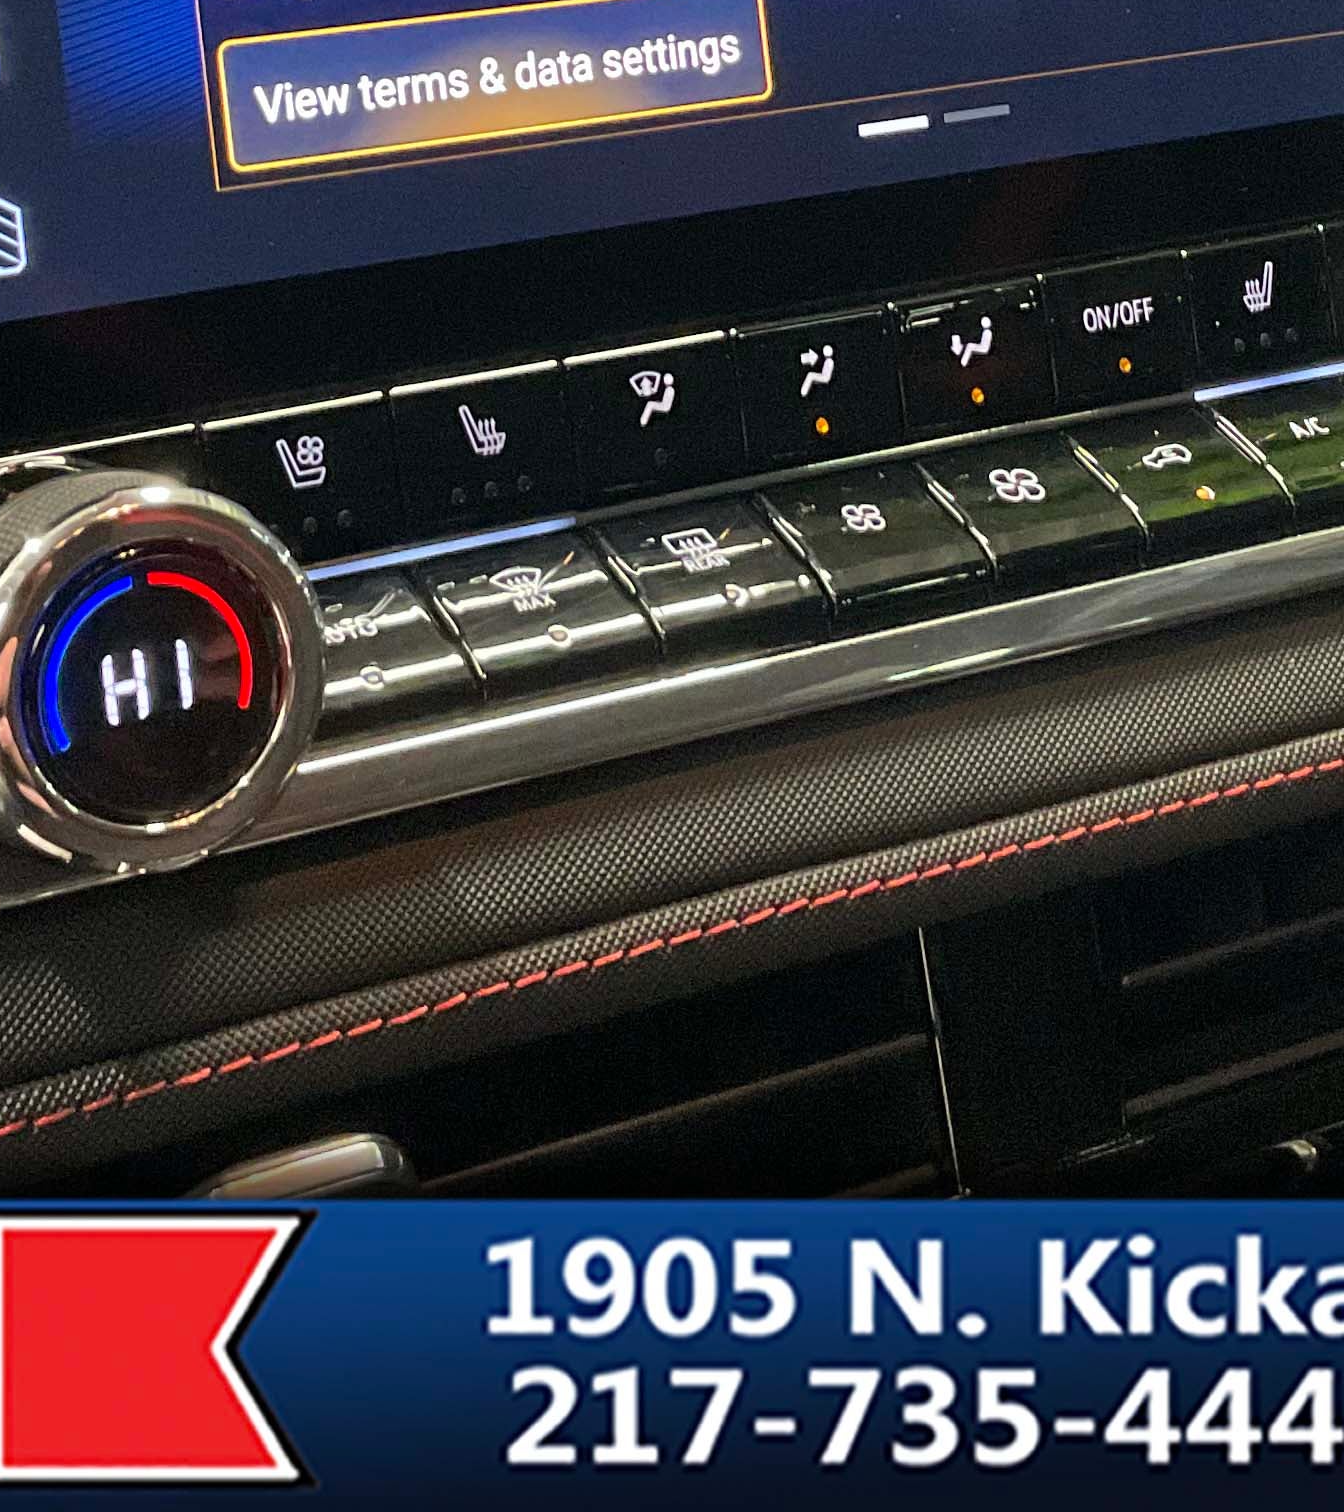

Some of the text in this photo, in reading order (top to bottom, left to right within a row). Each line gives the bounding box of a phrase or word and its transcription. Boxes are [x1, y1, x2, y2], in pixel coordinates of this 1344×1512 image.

[254, 34, 741, 124] View terms & data settings
[1083, 297, 1153, 332] ON/OFF
[1289, 417, 1329, 438] A/C
[513, 593, 556, 613] MAX
[102, 639, 193, 726] HI
